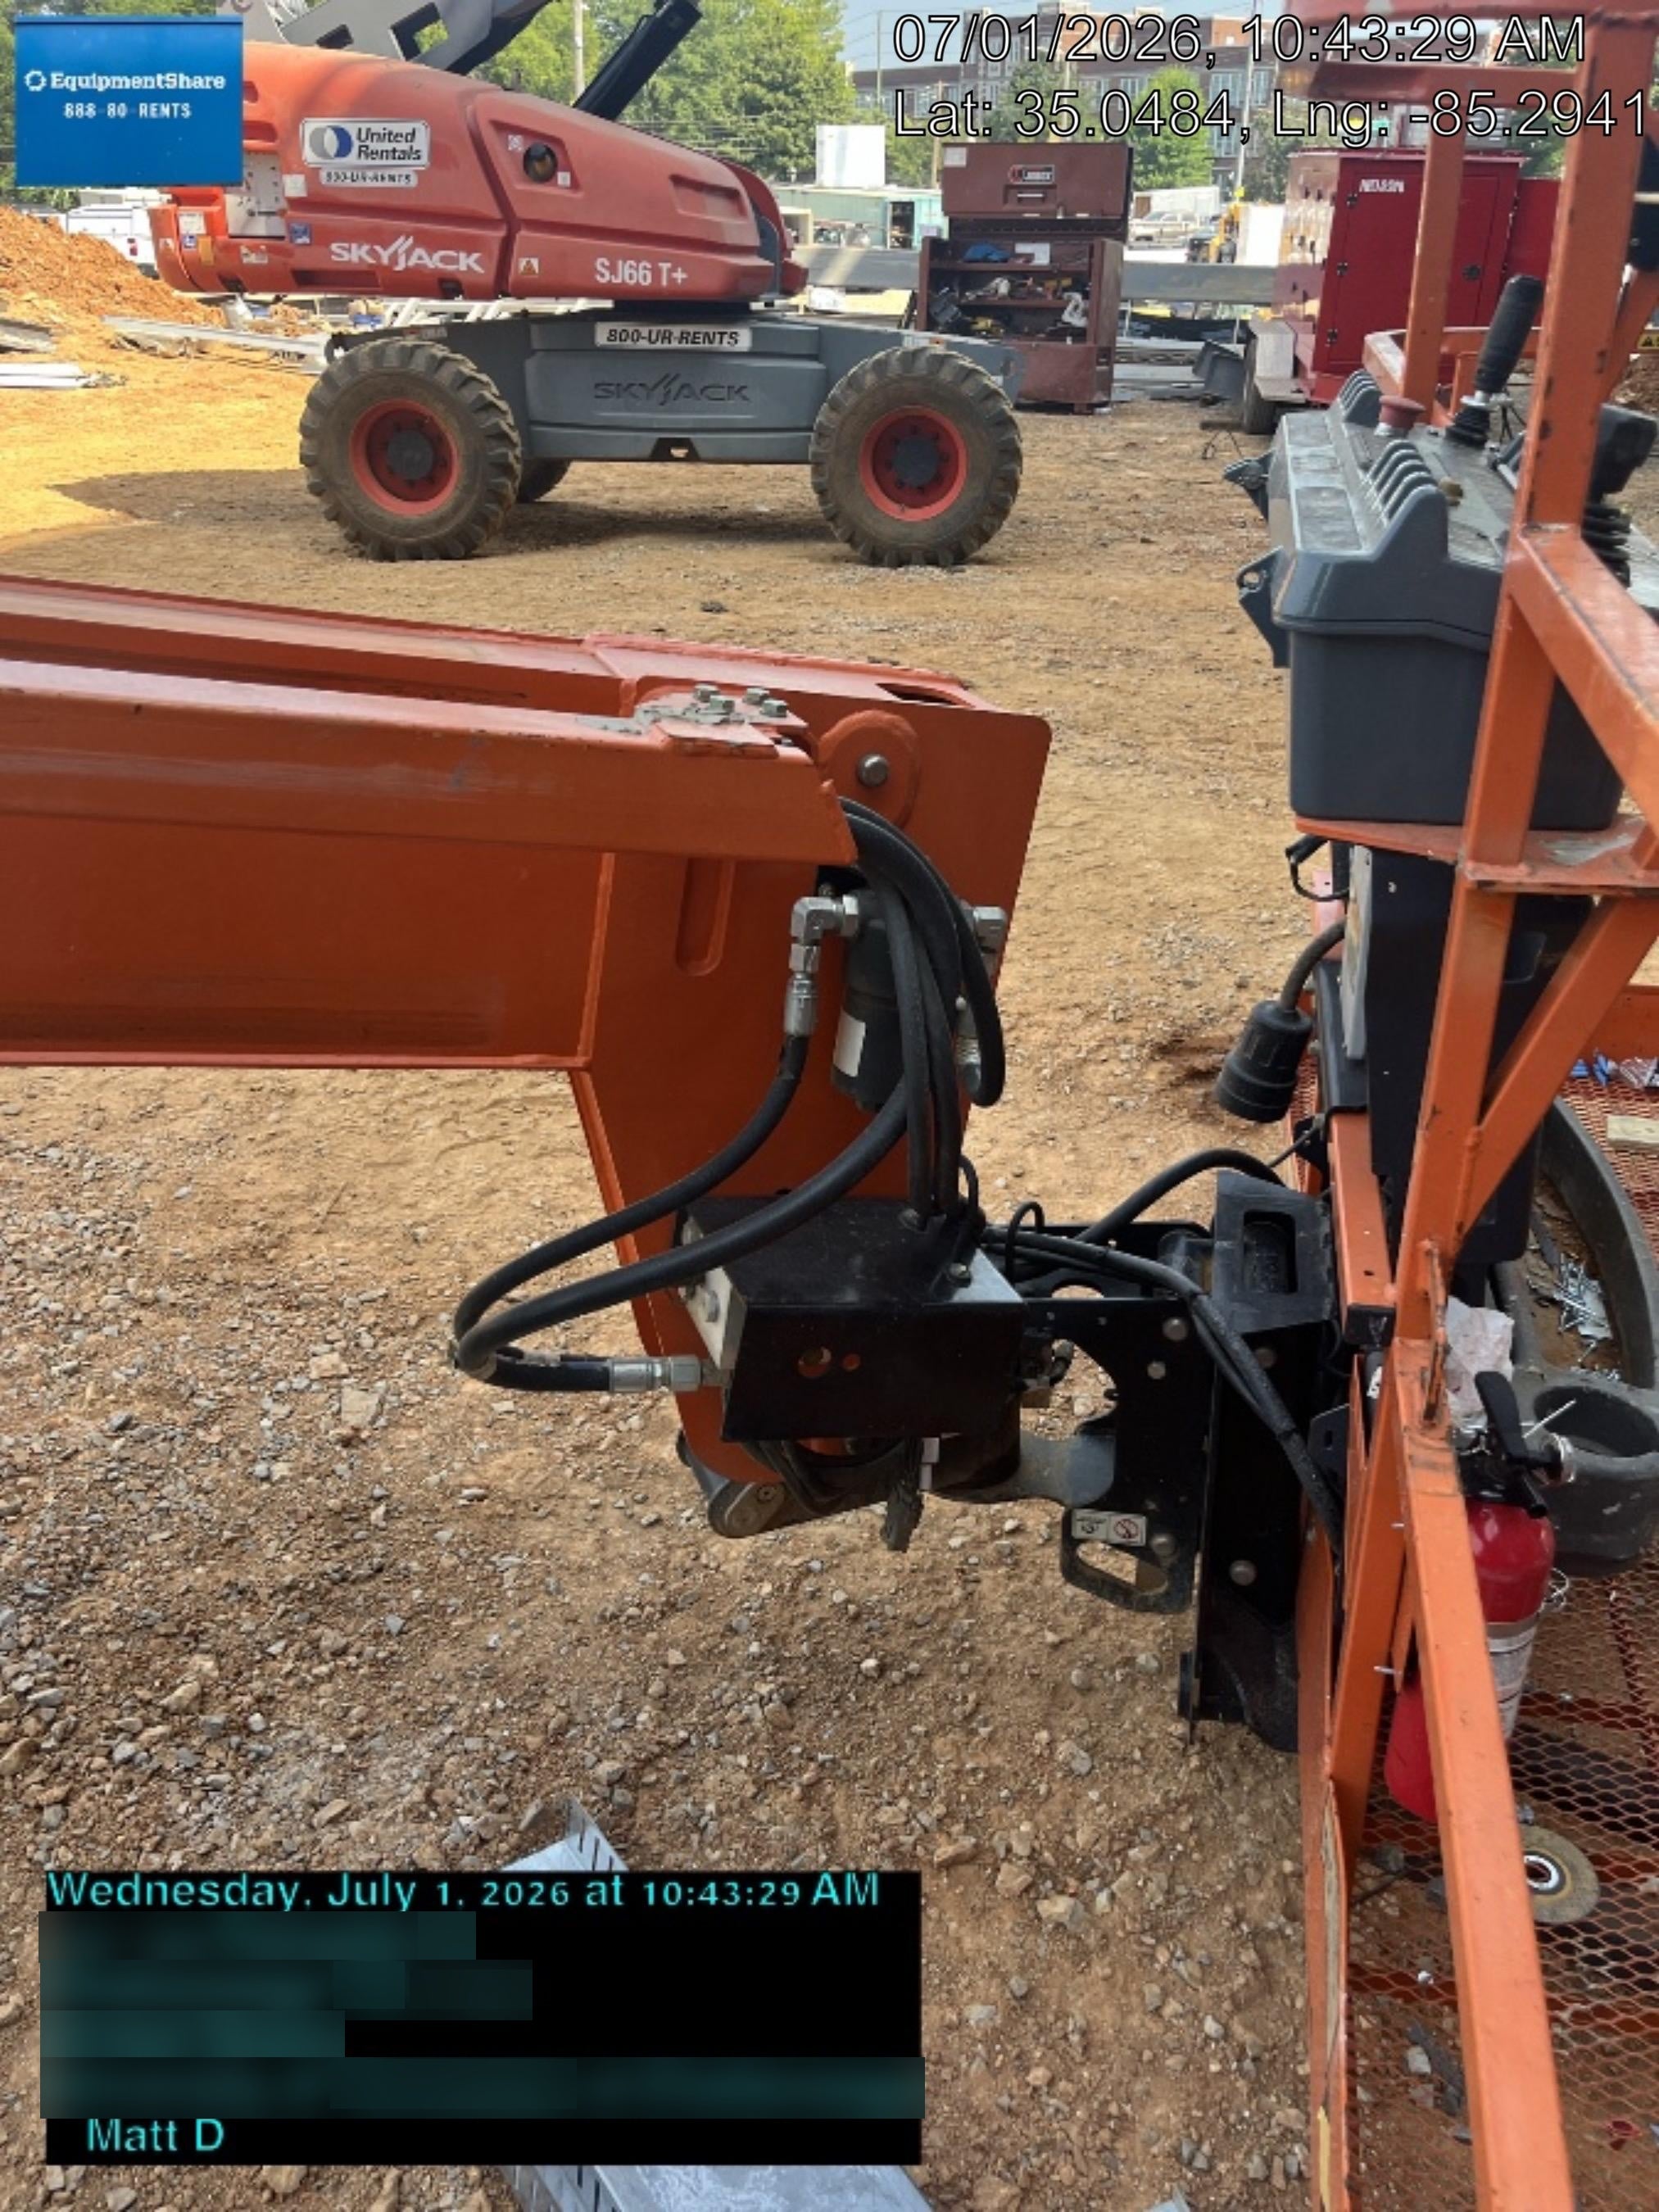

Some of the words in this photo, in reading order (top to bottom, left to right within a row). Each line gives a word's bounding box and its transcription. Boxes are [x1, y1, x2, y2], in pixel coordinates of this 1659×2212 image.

[356, 127, 416, 143] United
[356, 145, 422, 161] Rentals
[330, 235, 485, 274] SKYJACK
[595, 257, 652, 286] SJ66
[658, 262, 688, 286] T+
[606, 329, 741, 347] 800-UR-RENTS
[593, 373, 750, 406] SKYJACK
